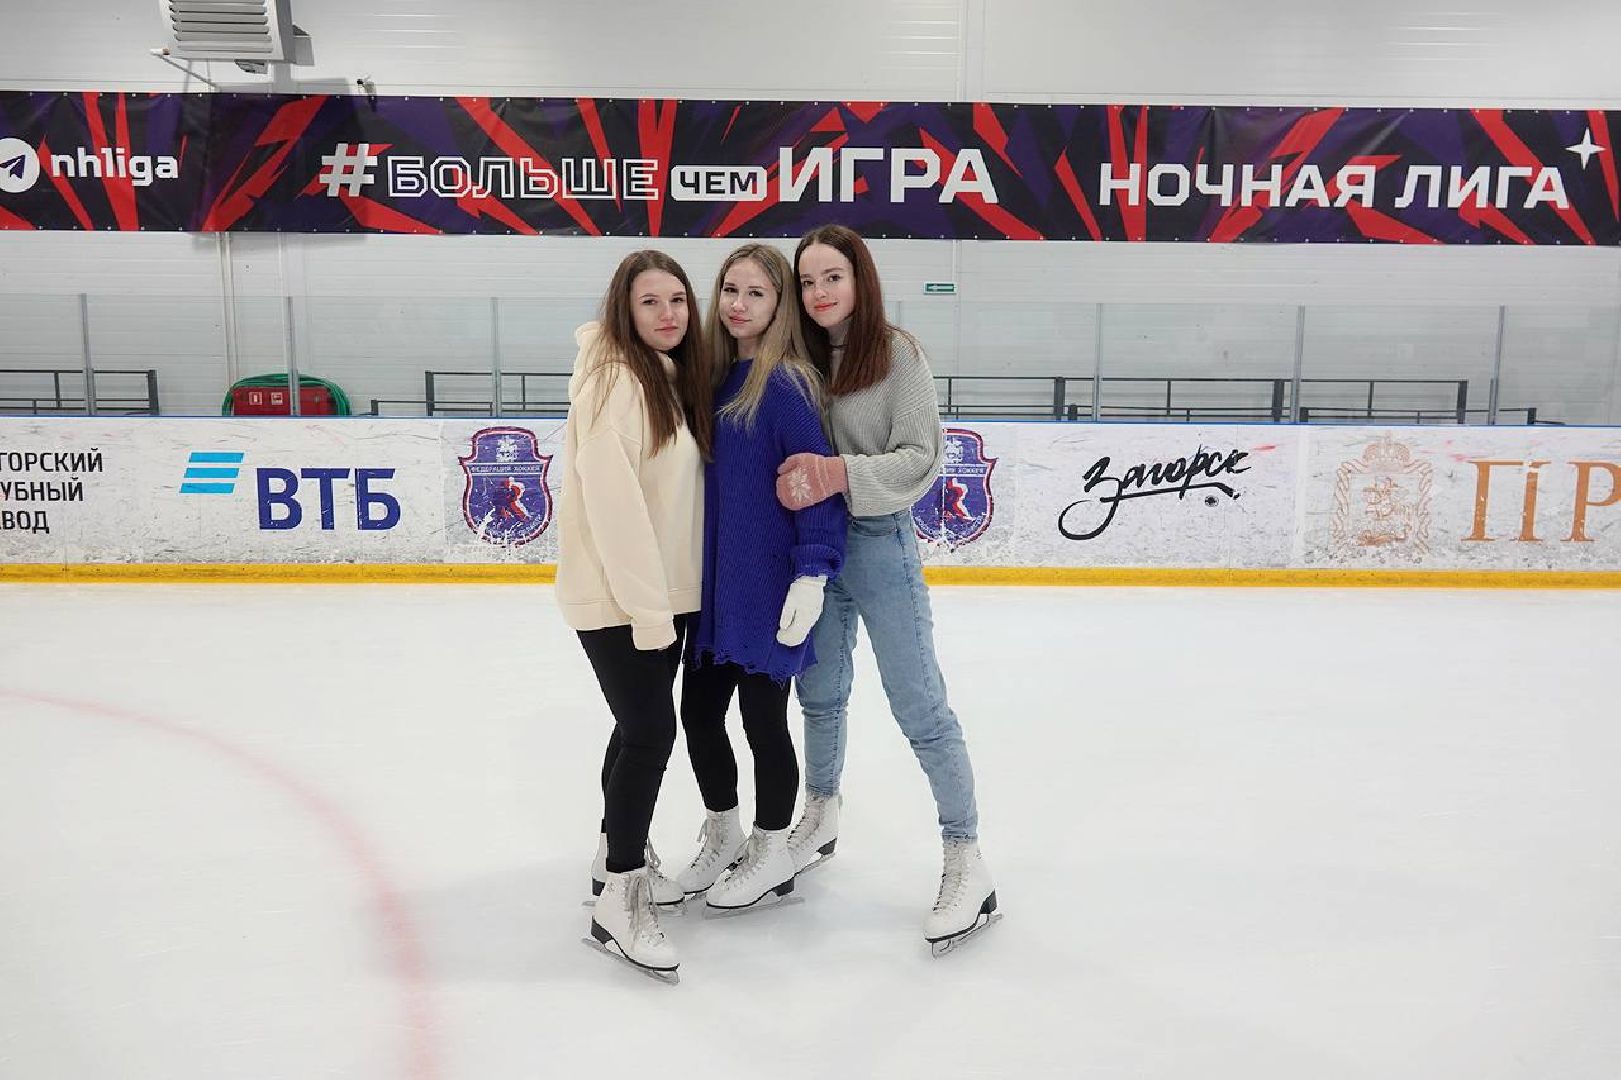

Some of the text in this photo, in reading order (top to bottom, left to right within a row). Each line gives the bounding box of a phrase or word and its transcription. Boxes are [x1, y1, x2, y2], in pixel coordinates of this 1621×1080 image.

[51, 147, 179, 186] nhliga
[679, 170, 758, 195] ЧЕМ
[779, 147, 1000, 204] ИГРА
[1099, 163, 1571, 210] НОЧНАЯ ЛИГА
[0, 510, 50, 534] ВОД
[256, 467, 402, 531] ВТБ
